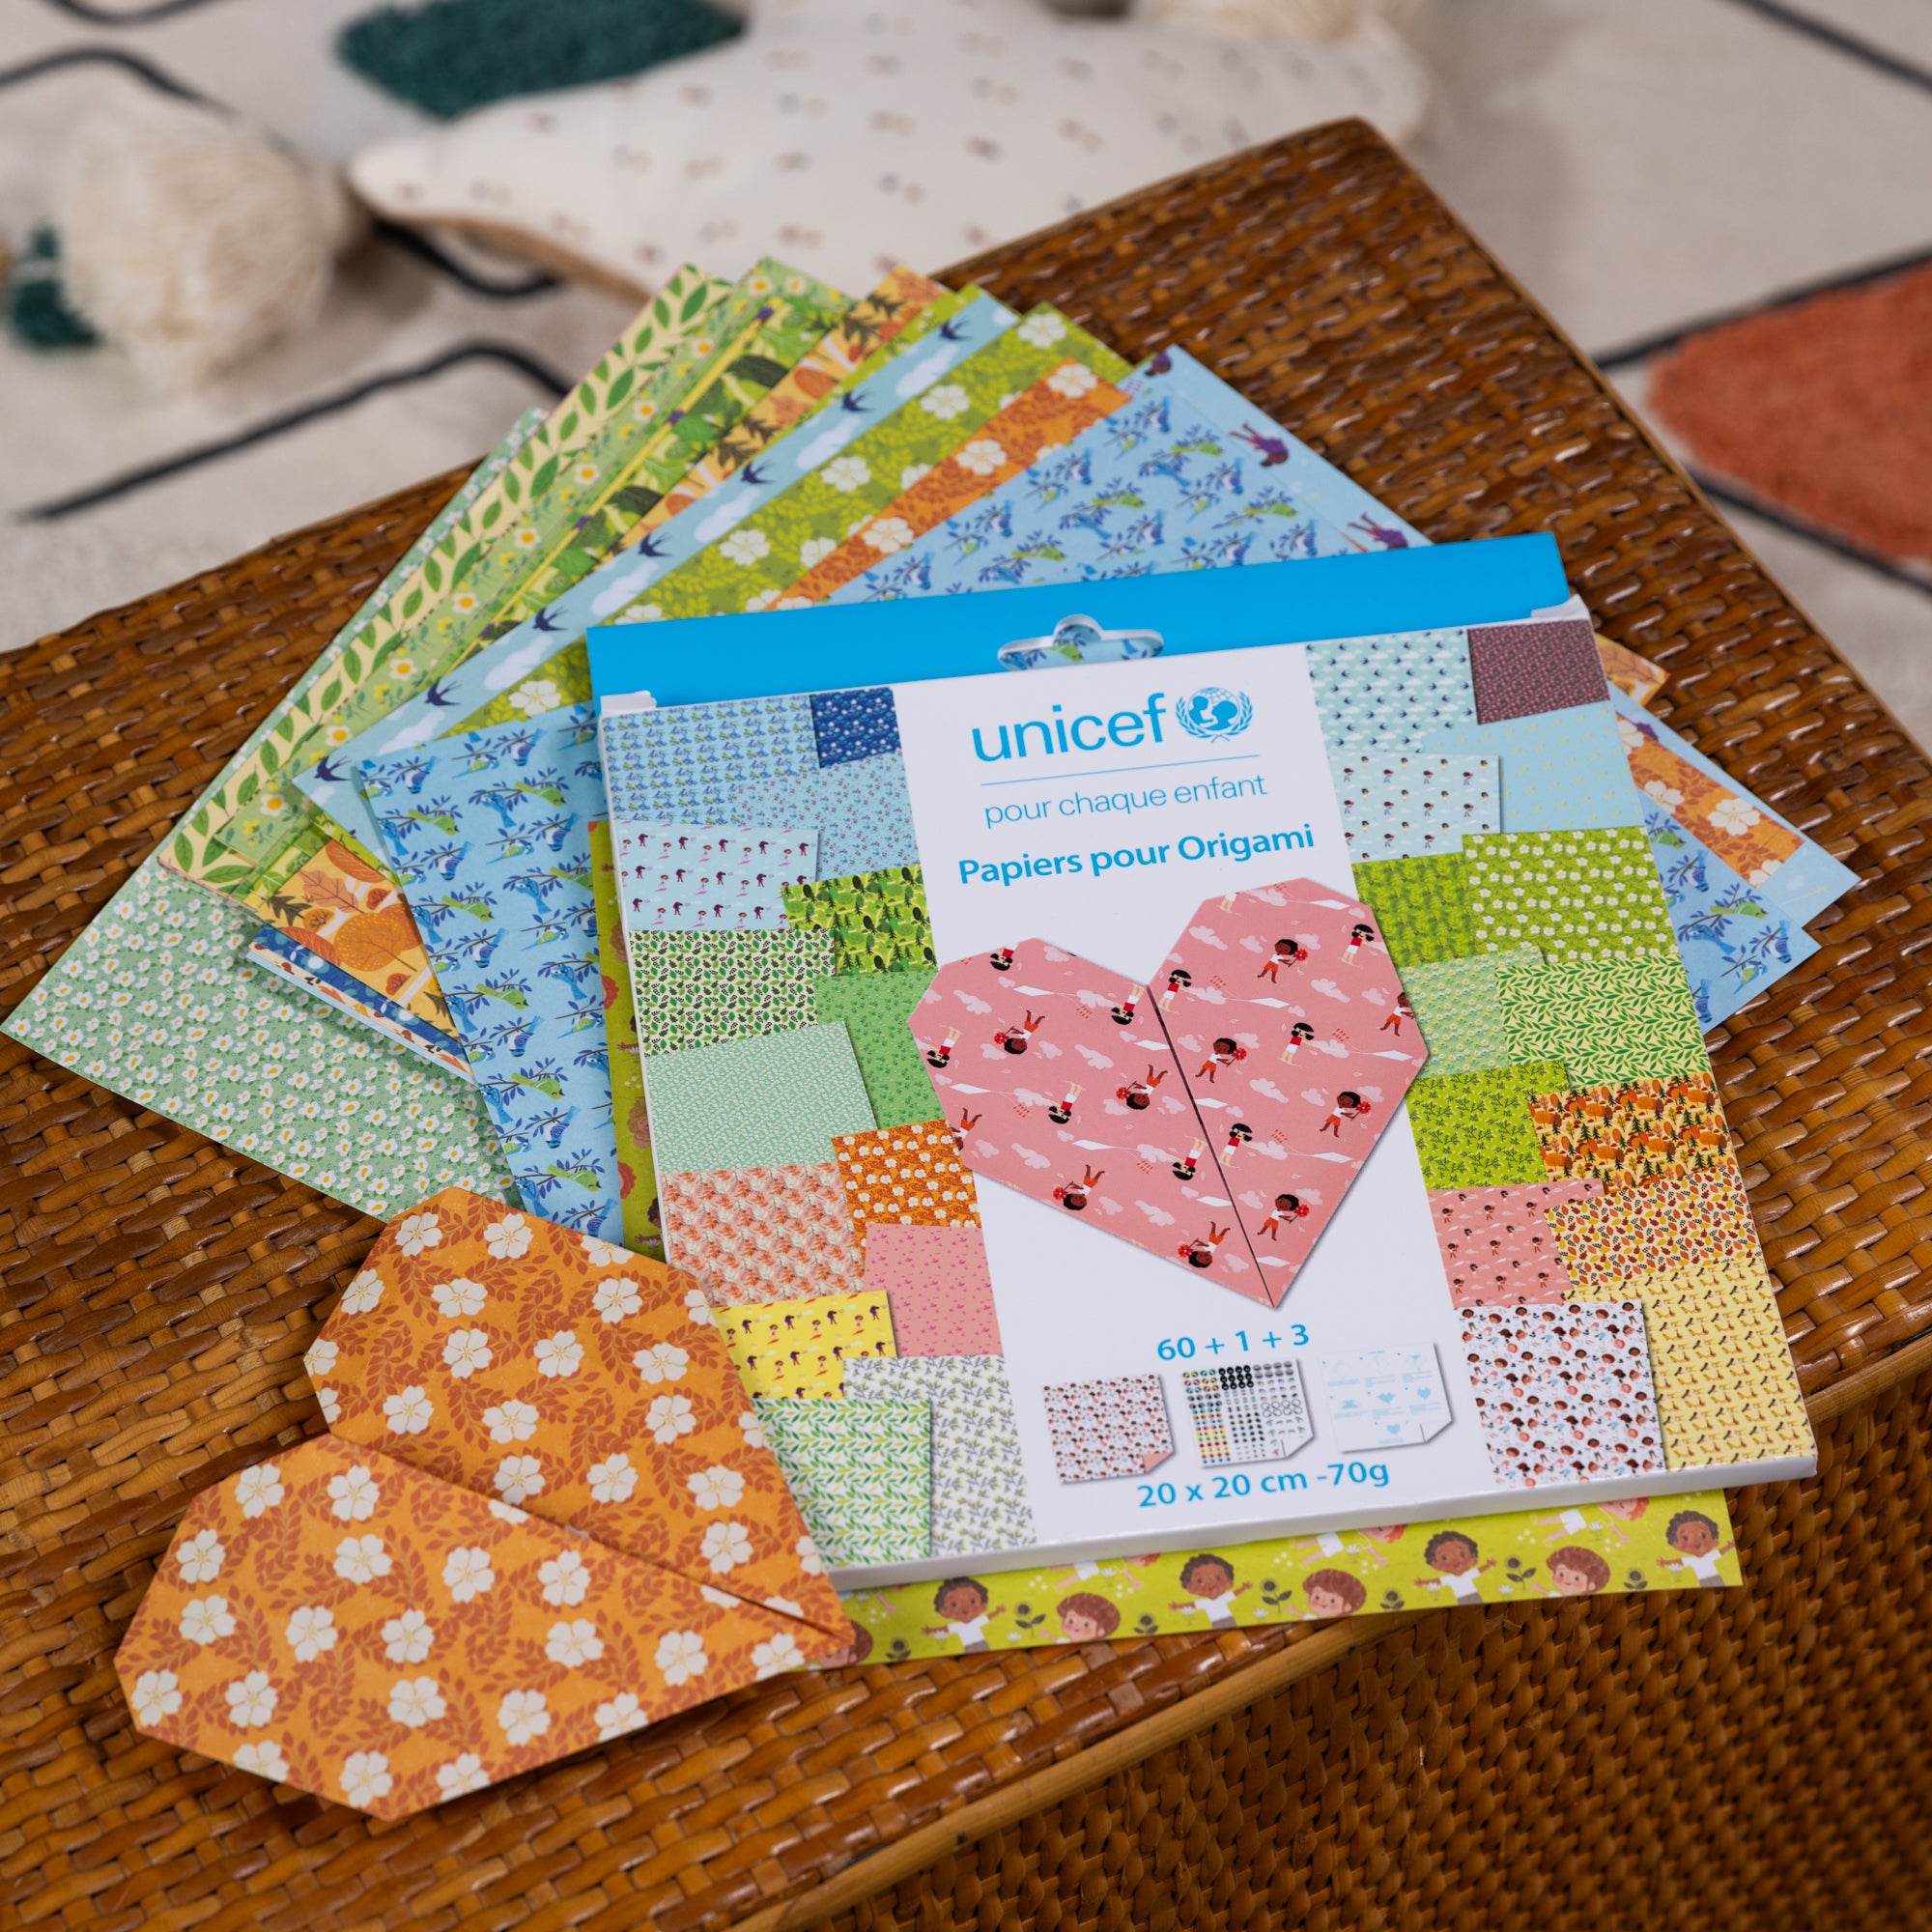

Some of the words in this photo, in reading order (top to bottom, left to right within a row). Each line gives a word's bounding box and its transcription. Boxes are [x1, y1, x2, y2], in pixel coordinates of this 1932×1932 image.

[971, 691, 1168, 763] unicef
[983, 799, 1053, 830] pour
[1058, 787, 1168, 817] chaque
[1173, 774, 1267, 807] enfant
[957, 852, 1084, 887] Papiers
[1089, 839, 1172, 878] pour
[1177, 822, 1316, 864] Origami
[1156, 1335, 1197, 1362] 60
[1205, 1337, 1226, 1356] +
[1235, 1329, 1250, 1353] 1
[1262, 1330, 1283, 1350] +
[1290, 1322, 1310, 1347] 3
[1137, 1482, 1178, 1508] 20
[1184, 1483, 1205, 1503] x
[1210, 1473, 1252, 1500] 20
[1260, 1472, 1309, 1493] cm
[1317, 1461, 1390, 1489] -70g
